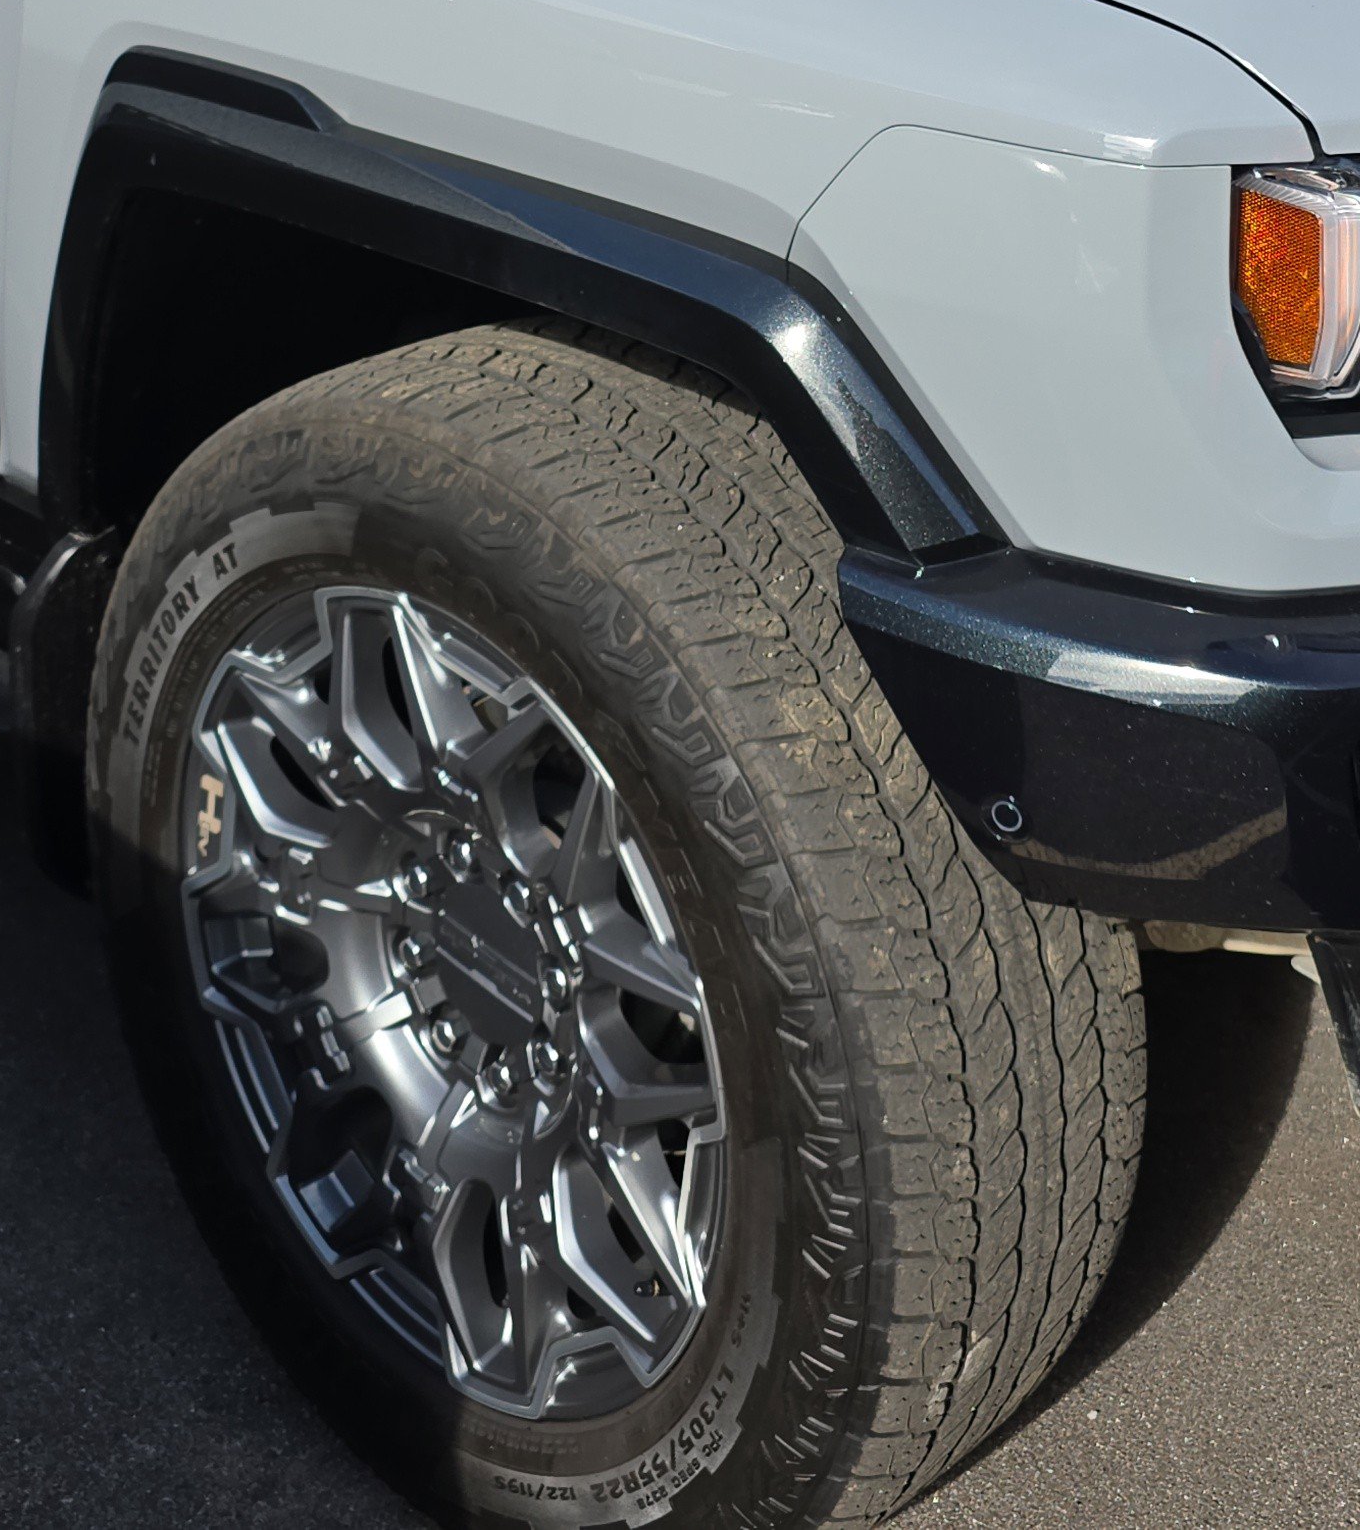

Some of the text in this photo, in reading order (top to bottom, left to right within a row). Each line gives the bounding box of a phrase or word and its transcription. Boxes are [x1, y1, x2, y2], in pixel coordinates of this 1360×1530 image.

[122, 574, 203, 746] TERRITORY
[211, 542, 240, 581] AT
[493, 1474, 577, 1501] 122/119S
[590, 1361, 735, 1503] LT305/55R22
